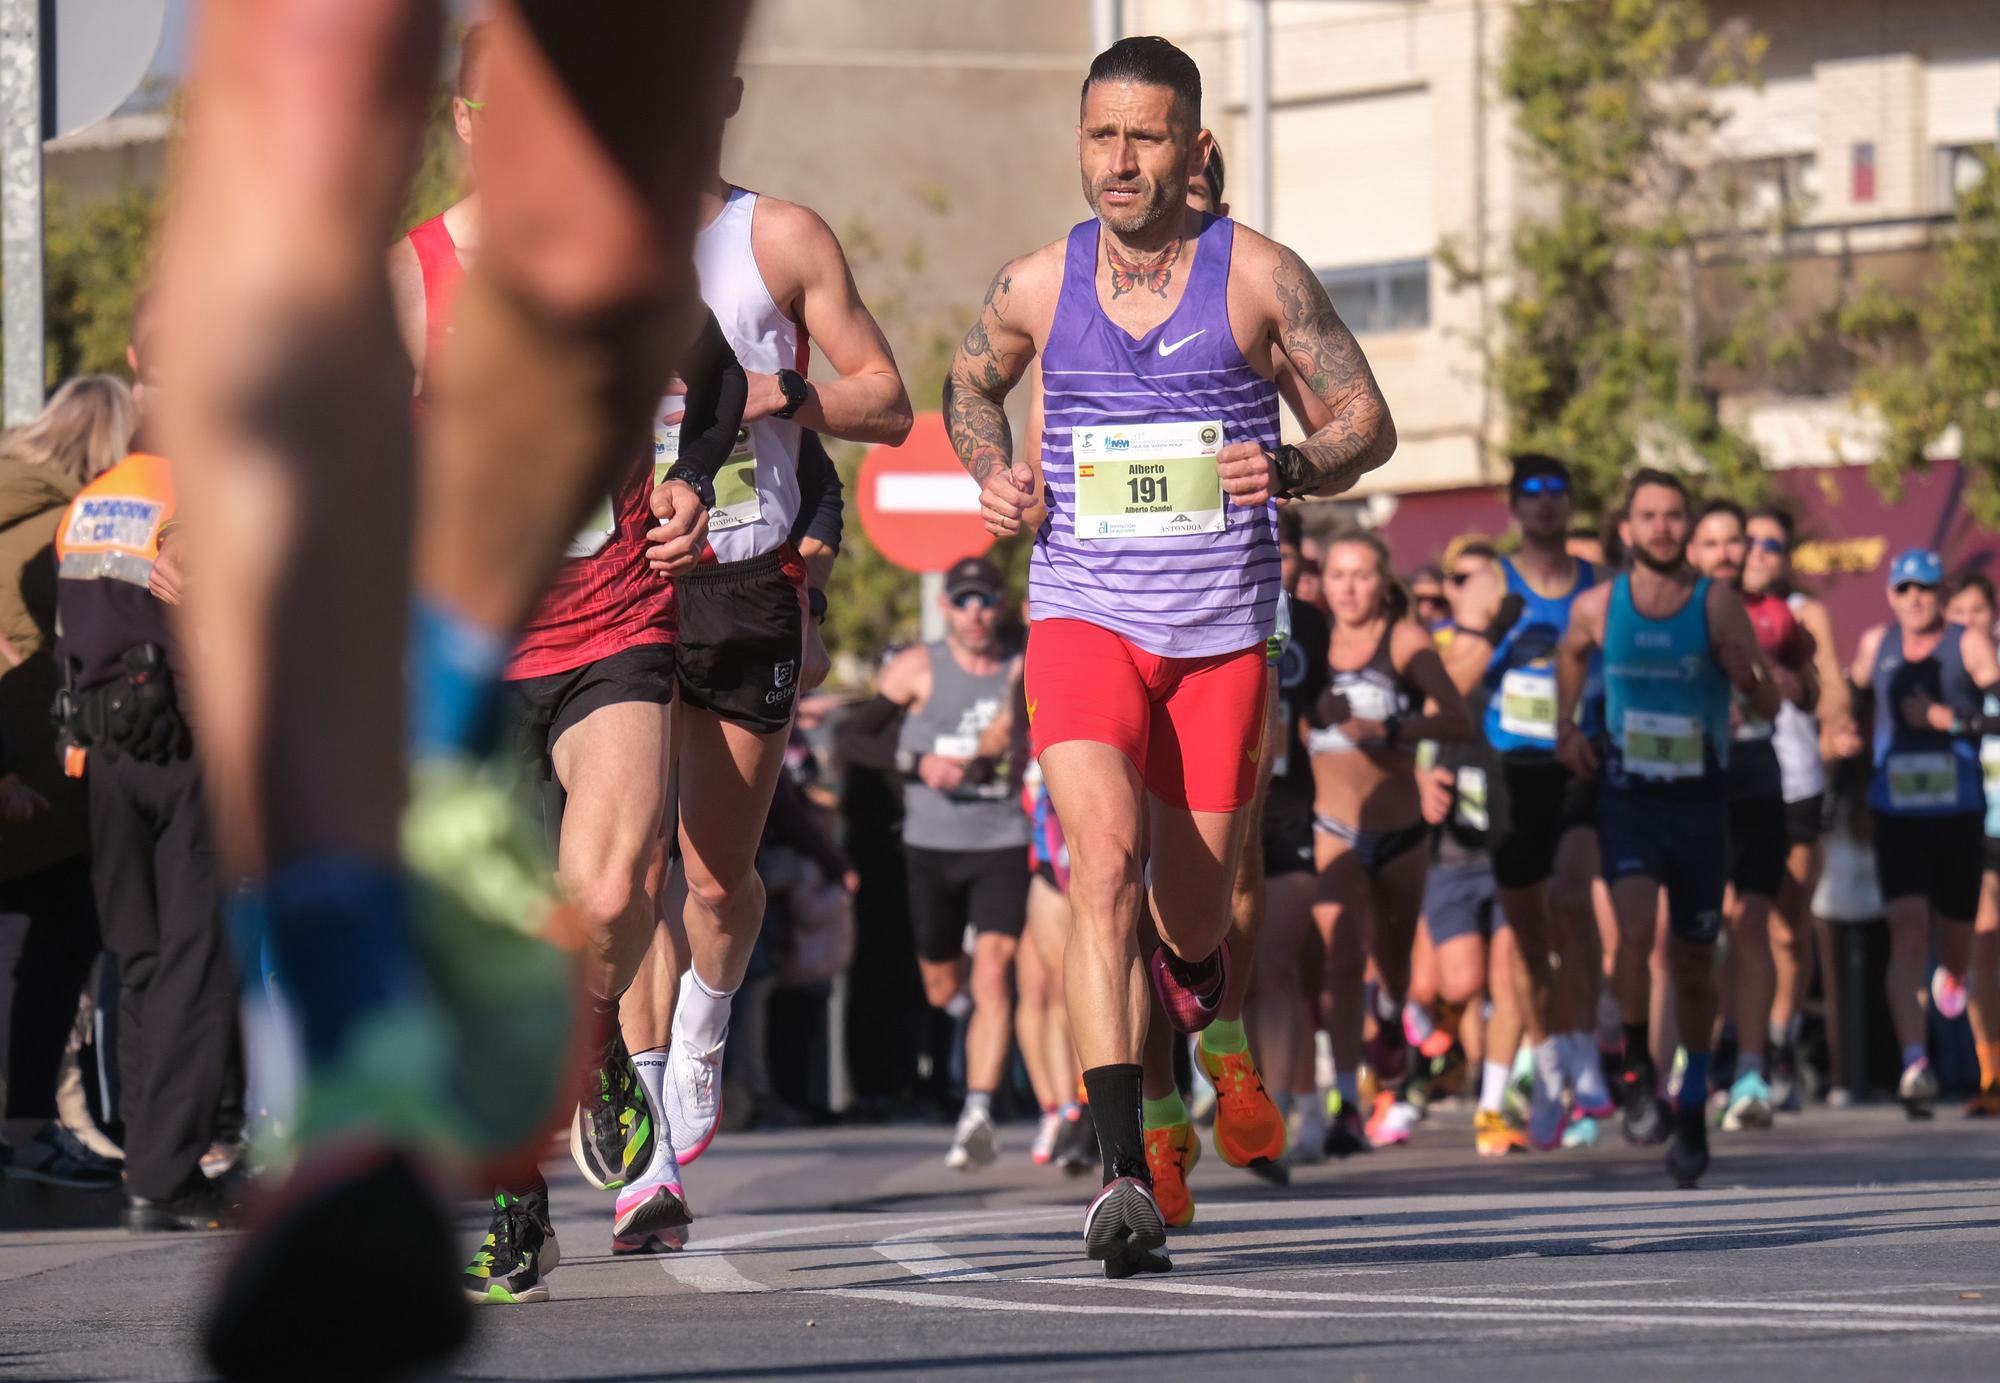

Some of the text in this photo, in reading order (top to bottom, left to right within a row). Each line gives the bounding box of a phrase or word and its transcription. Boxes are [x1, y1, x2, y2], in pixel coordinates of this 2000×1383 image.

[1129, 464, 1165, 475] Alberto
[1127, 476, 1168, 503] 191
[1125, 505, 1173, 514] Alberto Candel
[1161, 524, 1202, 533] ASTONDOA
